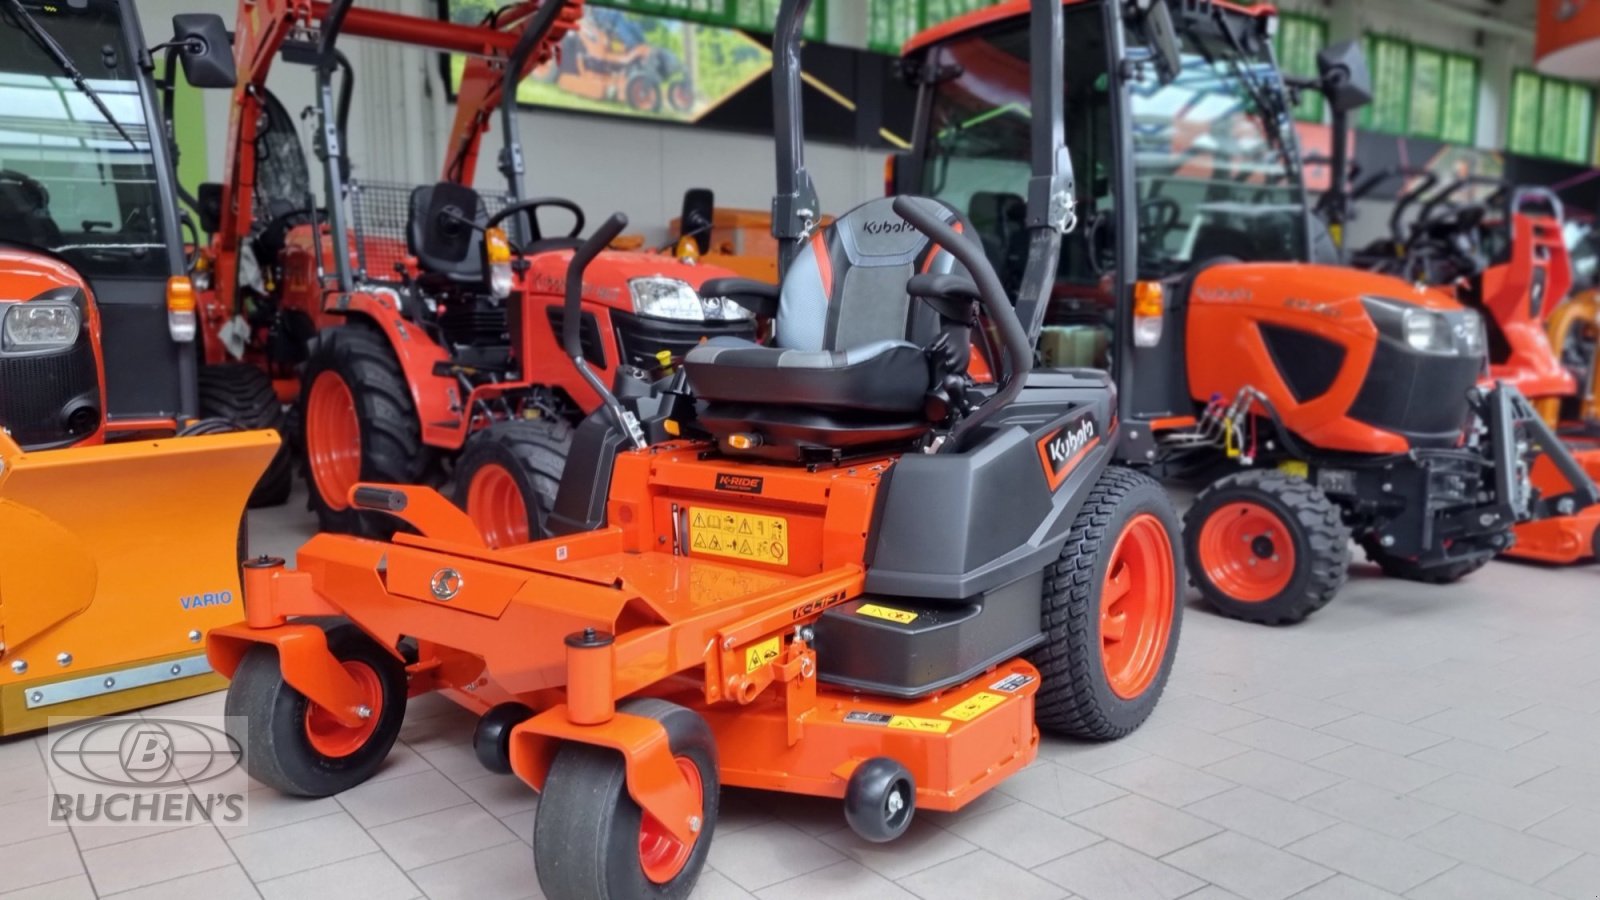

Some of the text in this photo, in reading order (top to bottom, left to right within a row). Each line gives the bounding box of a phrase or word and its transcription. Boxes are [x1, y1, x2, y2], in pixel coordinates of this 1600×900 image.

[1050, 419, 1094, 461] Kubota
[719, 476, 760, 488] K-RIDE
[180, 591, 232, 610] VARIO
